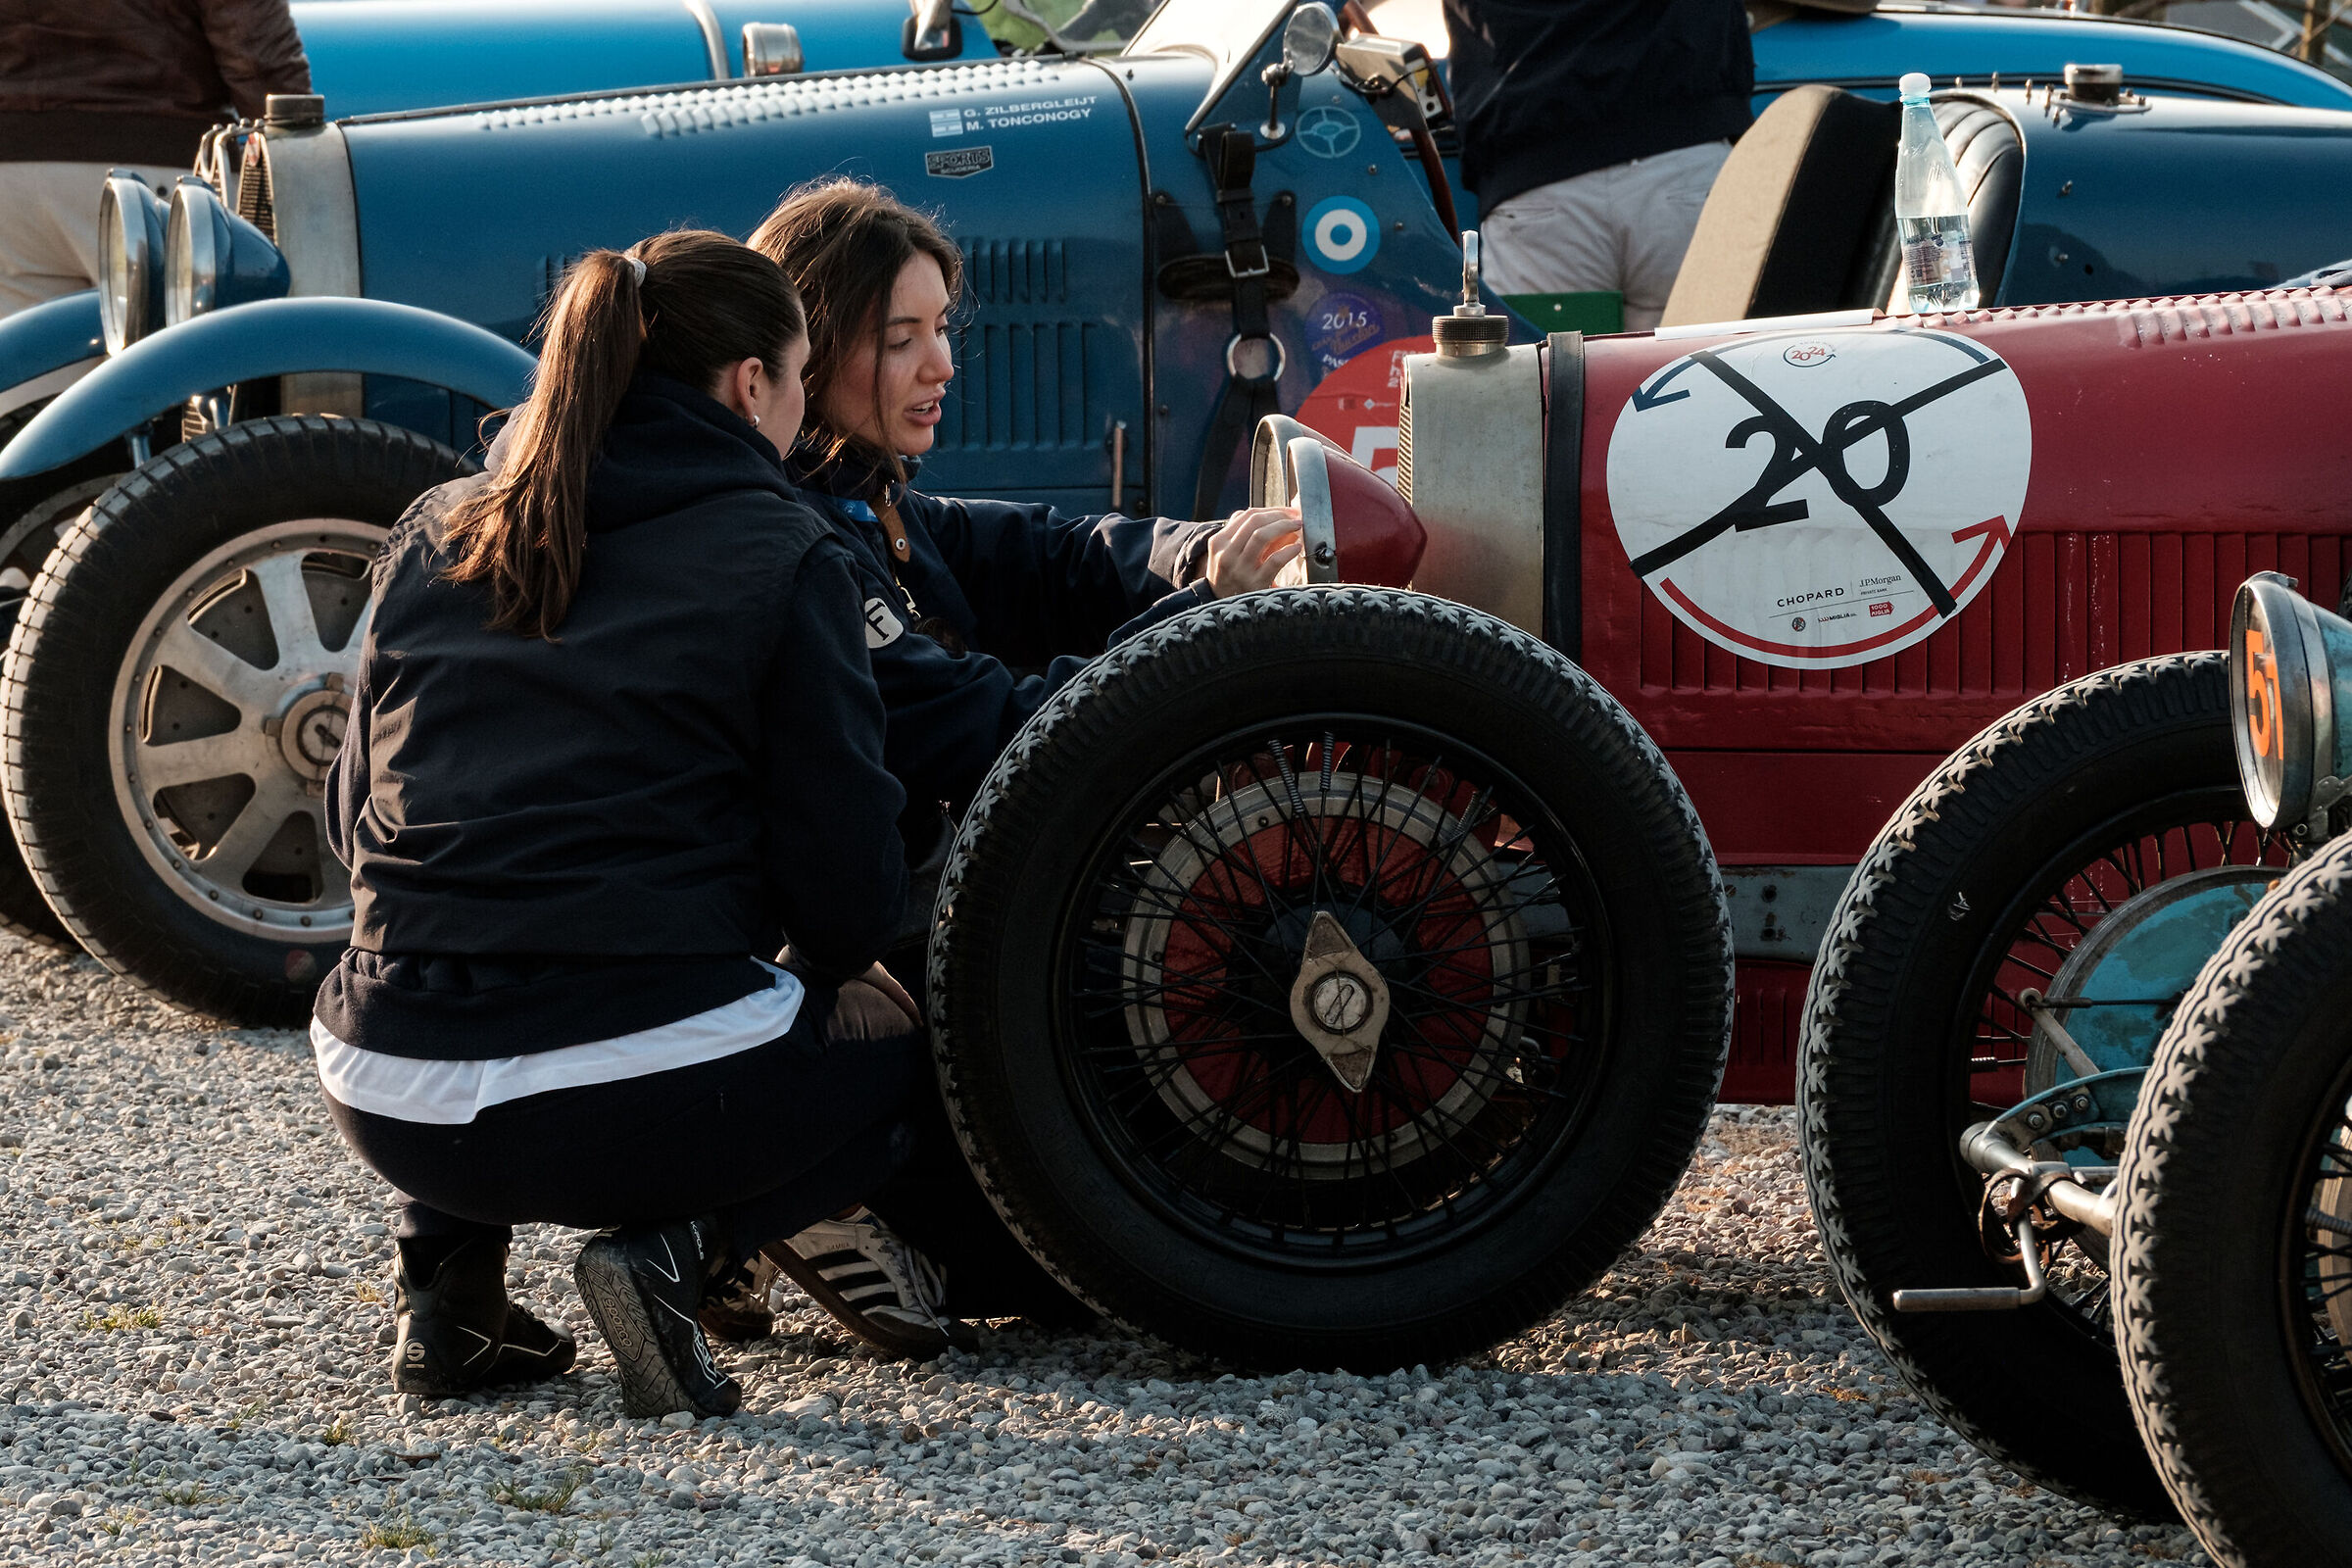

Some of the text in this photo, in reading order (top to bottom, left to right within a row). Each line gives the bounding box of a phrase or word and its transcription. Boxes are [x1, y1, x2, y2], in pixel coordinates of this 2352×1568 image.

[964, 108, 980, 118] G.
[966, 108, 1091, 131] M. TONCONOGY
[1322, 312, 1367, 329] 2015
[1791, 346, 1826, 361] 2024
[1725, 400, 1910, 533] 20
[1777, 587, 1844, 608] CHOPARD
